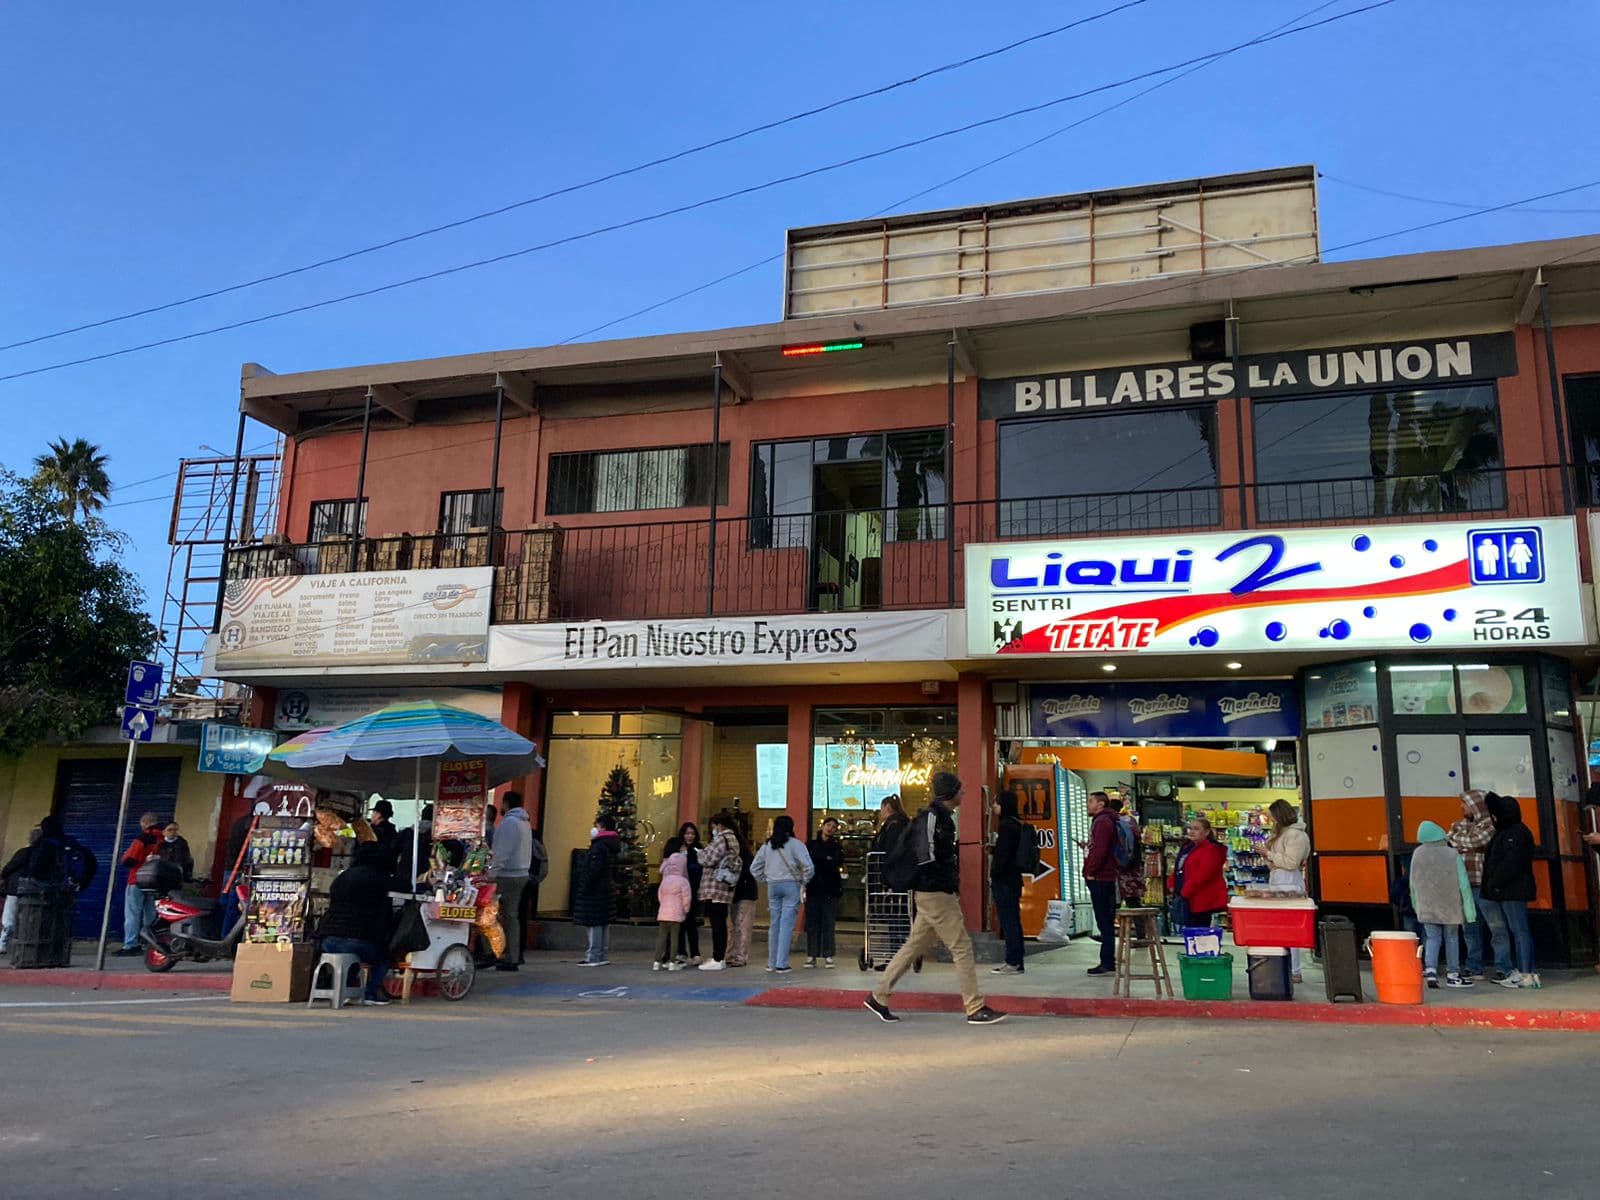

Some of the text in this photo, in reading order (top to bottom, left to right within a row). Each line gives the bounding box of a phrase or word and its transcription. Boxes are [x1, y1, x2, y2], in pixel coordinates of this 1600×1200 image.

[1015, 341, 1473, 413] BILLARES LA UNION
[1215, 534, 1322, 596] 2
[310, 576, 408, 588] VIAJE A CALIFORNIA
[992, 597, 1071, 612] SENTRI
[1474, 607, 1550, 625] 24
[564, 620, 858, 661] El Pan Nuestro Express
[1047, 617, 1156, 651] TECATE
[1474, 626, 1551, 641] HORAS
[1042, 695, 1100, 713] Marinela
[1128, 694, 1188, 713] Marinela
[1218, 692, 1280, 713] Marinela
[442, 760, 484, 771] ELOTES
[843, 763, 933, 790] Chilaquiles!
[440, 907, 476, 918] ELOTES
